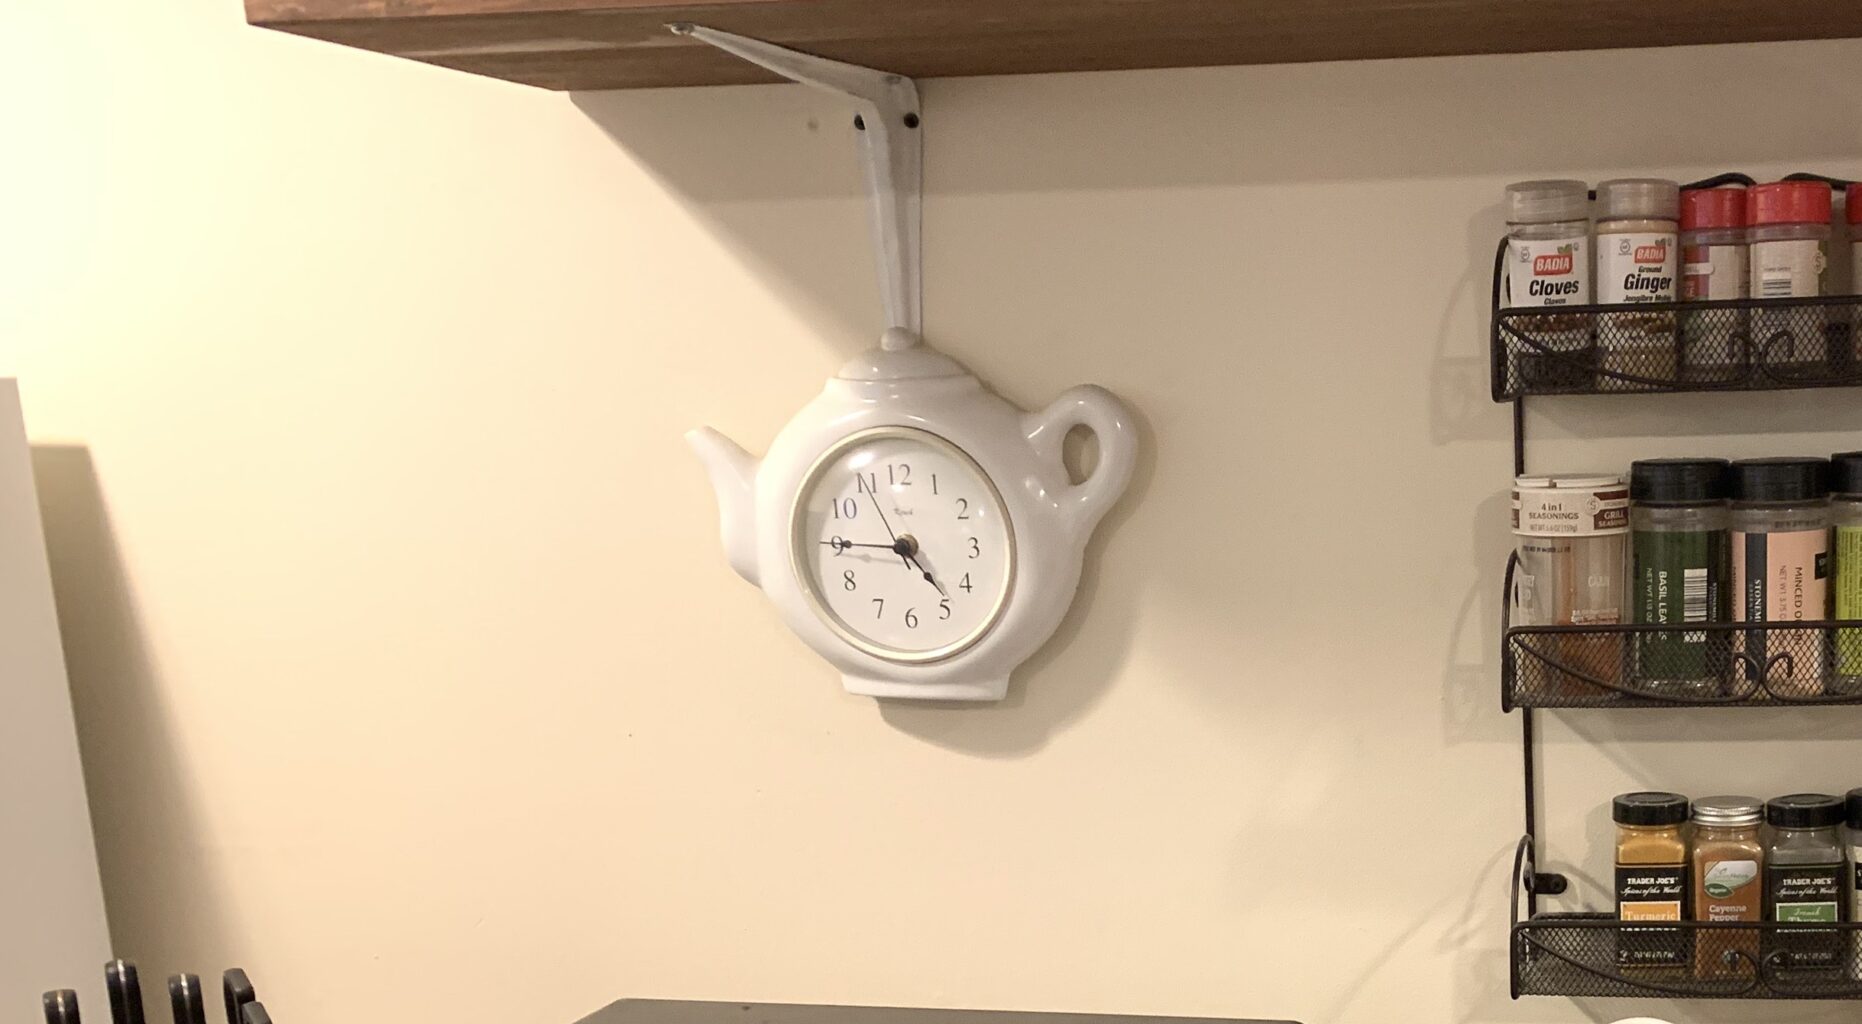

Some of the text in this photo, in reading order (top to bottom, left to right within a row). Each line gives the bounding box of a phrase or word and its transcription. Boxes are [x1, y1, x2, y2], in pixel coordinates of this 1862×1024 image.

[1536, 257, 1570, 271] BADIA
[1637, 249, 1664, 260] BADIA
[1529, 280, 1579, 296] Cloves
[1624, 273, 1672, 293] Ginger
[888, 464, 912, 486] 12
[931, 473, 938, 495] 1
[832, 497, 857, 519] 10
[955, 498, 969, 520] 2
[1528, 512, 1580, 520] SEASONINGS
[1541, 503, 1546, 511] 4
[1548, 503, 1557, 511] in
[831, 535, 844, 557] 9
[968, 537, 980, 559] 3
[843, 570, 856, 591] 8
[958, 572, 973, 594] 4
[1658, 571, 1667, 600] BASIL
[1794, 567, 1803, 608] MINCED
[1646, 585, 1653, 598] WT
[872, 599, 884, 619] 7
[905, 607, 918, 629] 6
[939, 599, 951, 620] 5
[1625, 911, 1676, 921] Turmeric
[1709, 905, 1747, 914] Cayenne
